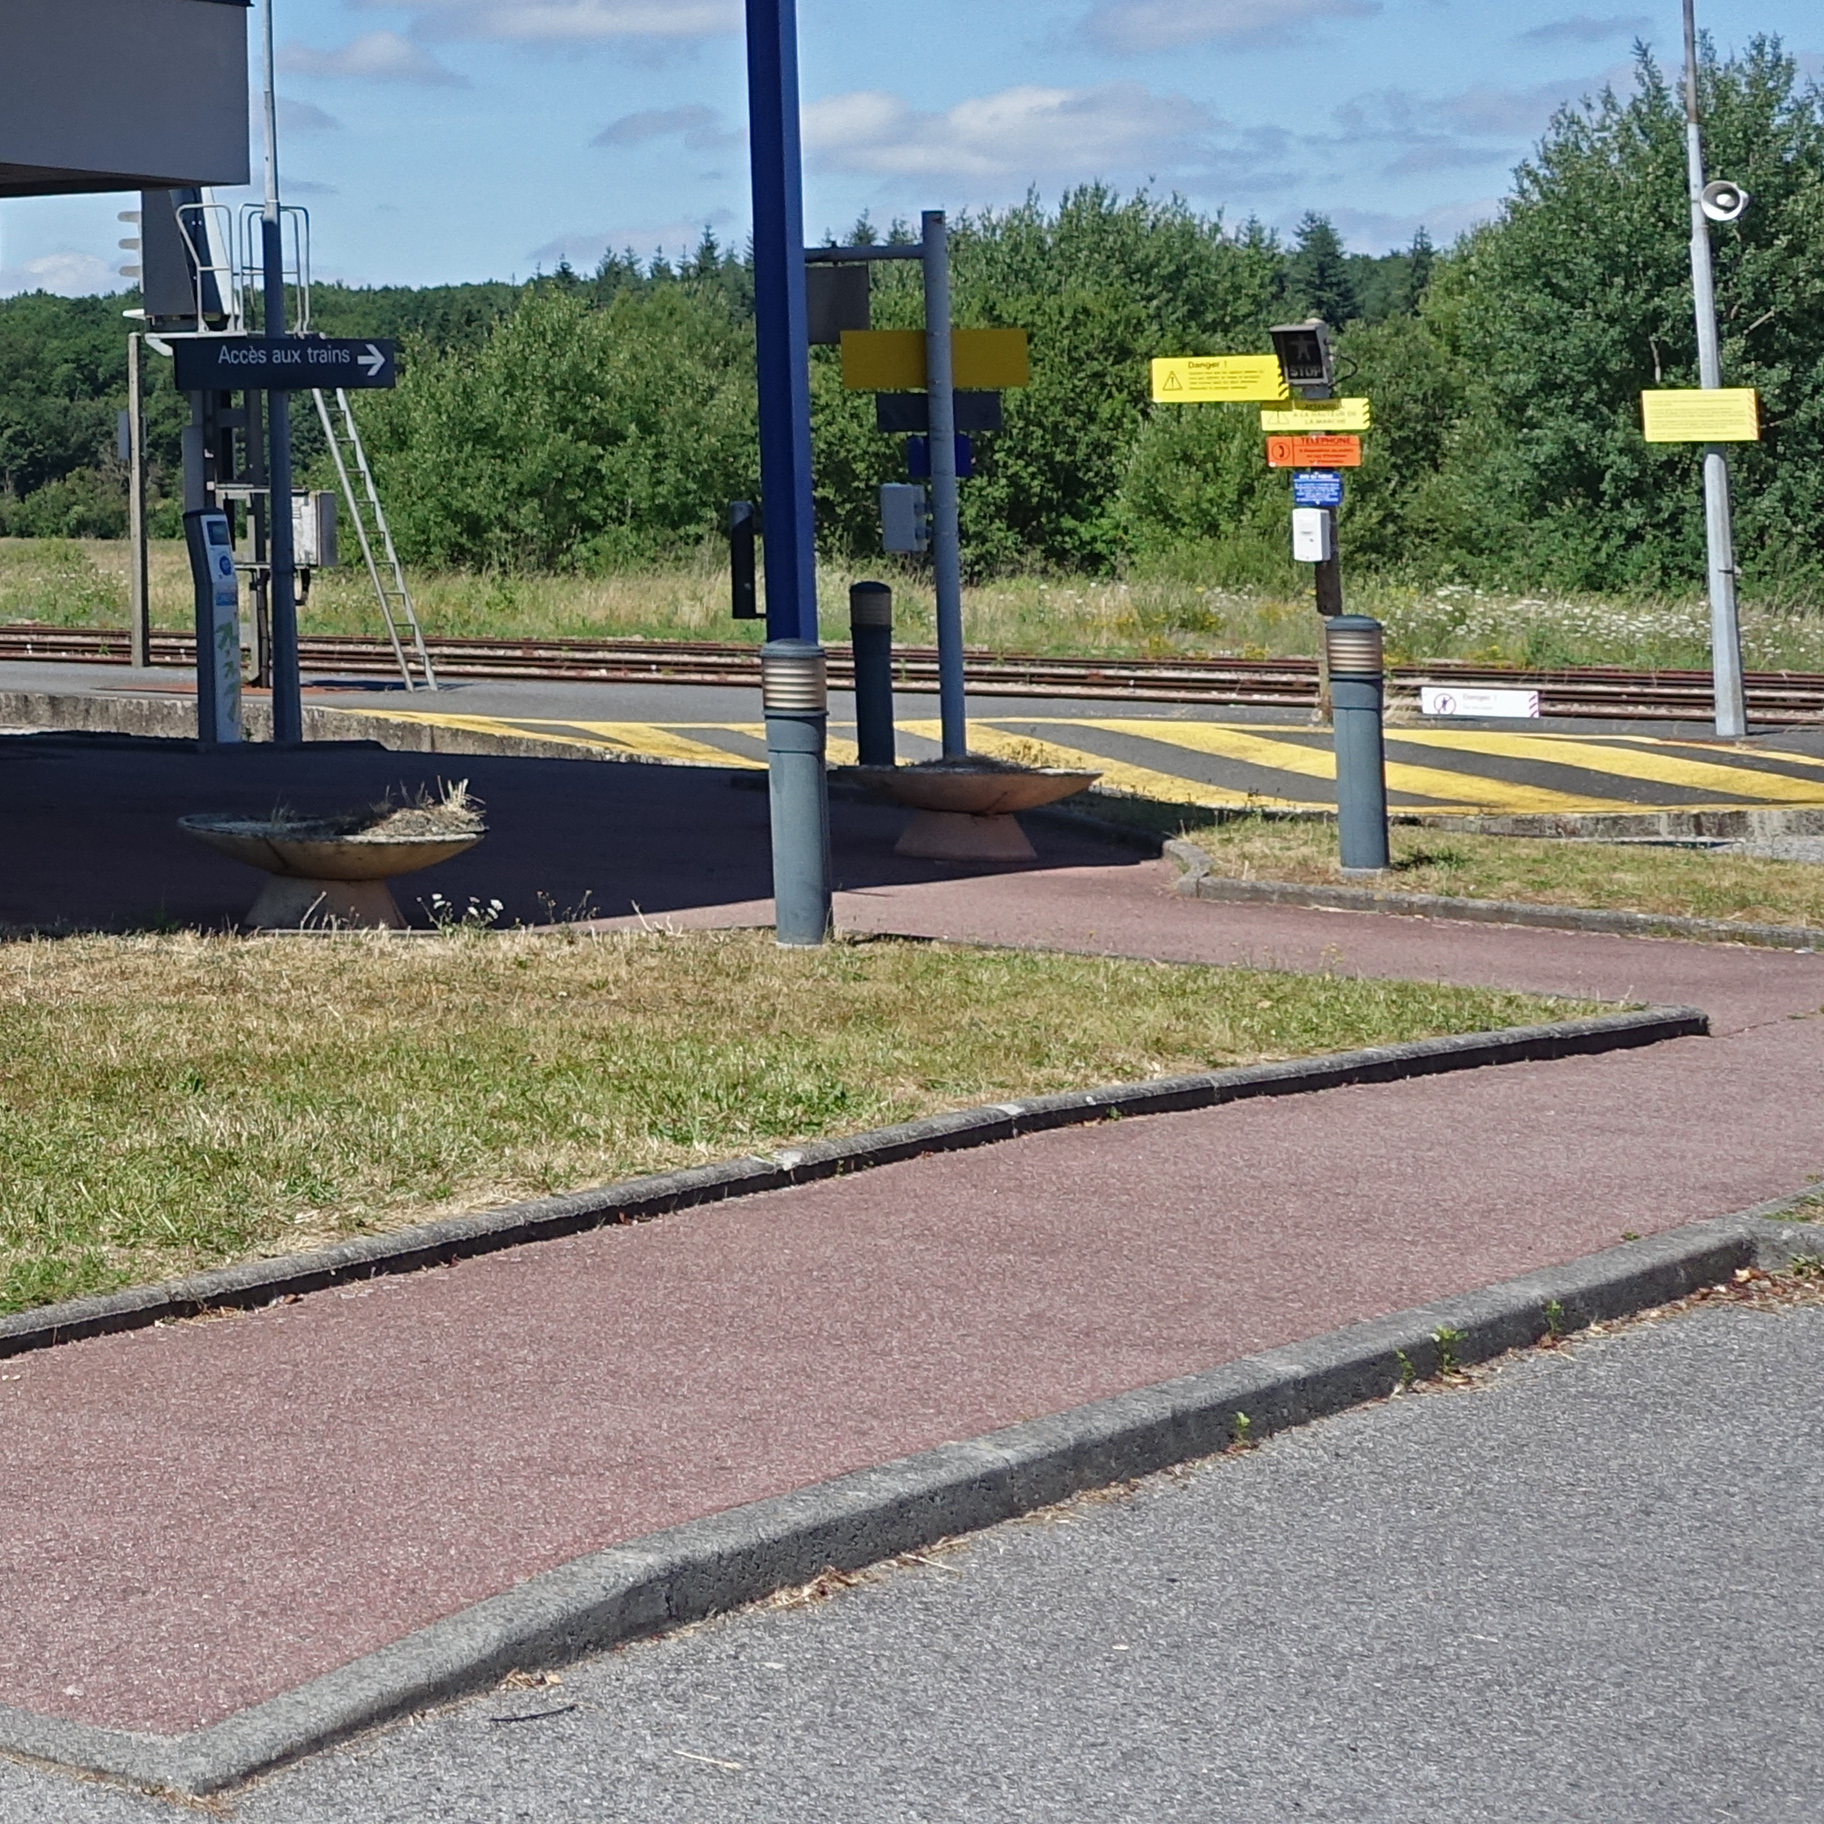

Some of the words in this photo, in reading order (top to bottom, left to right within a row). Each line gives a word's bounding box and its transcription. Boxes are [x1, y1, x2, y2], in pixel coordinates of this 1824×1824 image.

[218, 344, 267, 366] Accès
[272, 348, 302, 365] aux
[306, 345, 351, 365] trains
[1187, 361, 1220, 370] Danger
[1290, 366, 1322, 377] STOP
